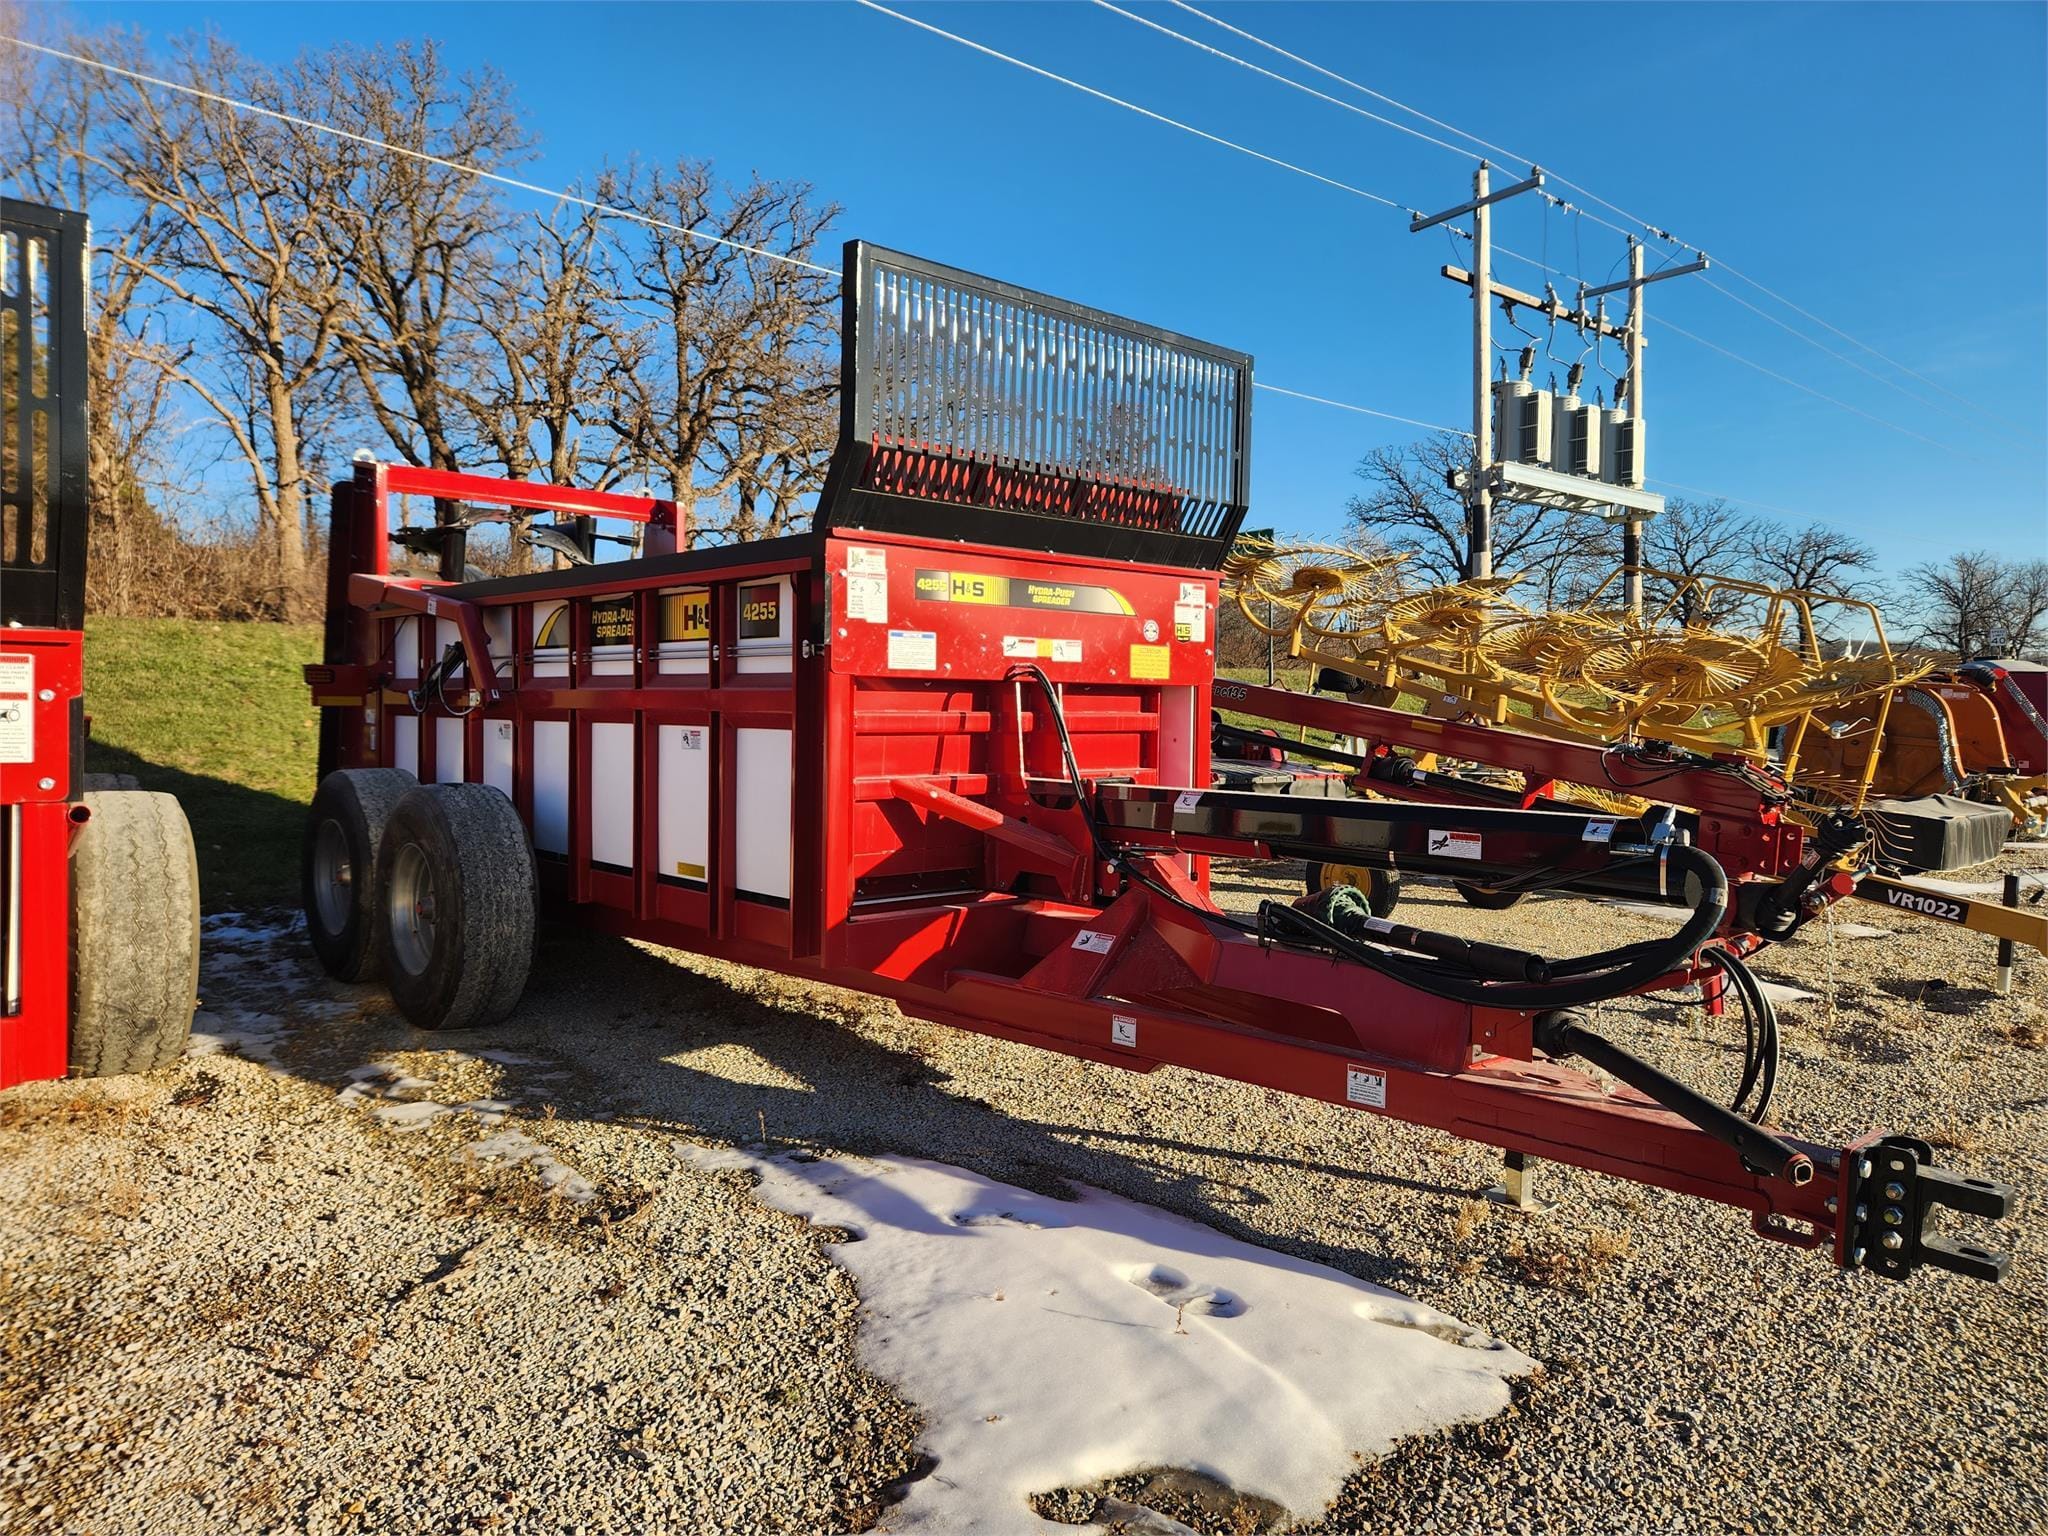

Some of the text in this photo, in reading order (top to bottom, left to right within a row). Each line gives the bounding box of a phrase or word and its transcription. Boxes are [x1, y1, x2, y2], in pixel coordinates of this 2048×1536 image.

[916, 578, 985, 597] 4255 H&S
[1028, 584, 1075, 598] HYDRA-PUSH
[1032, 595, 1071, 606] SPREADER
[743, 602, 776, 621] 4255
[1888, 889, 1961, 920] VR1022
